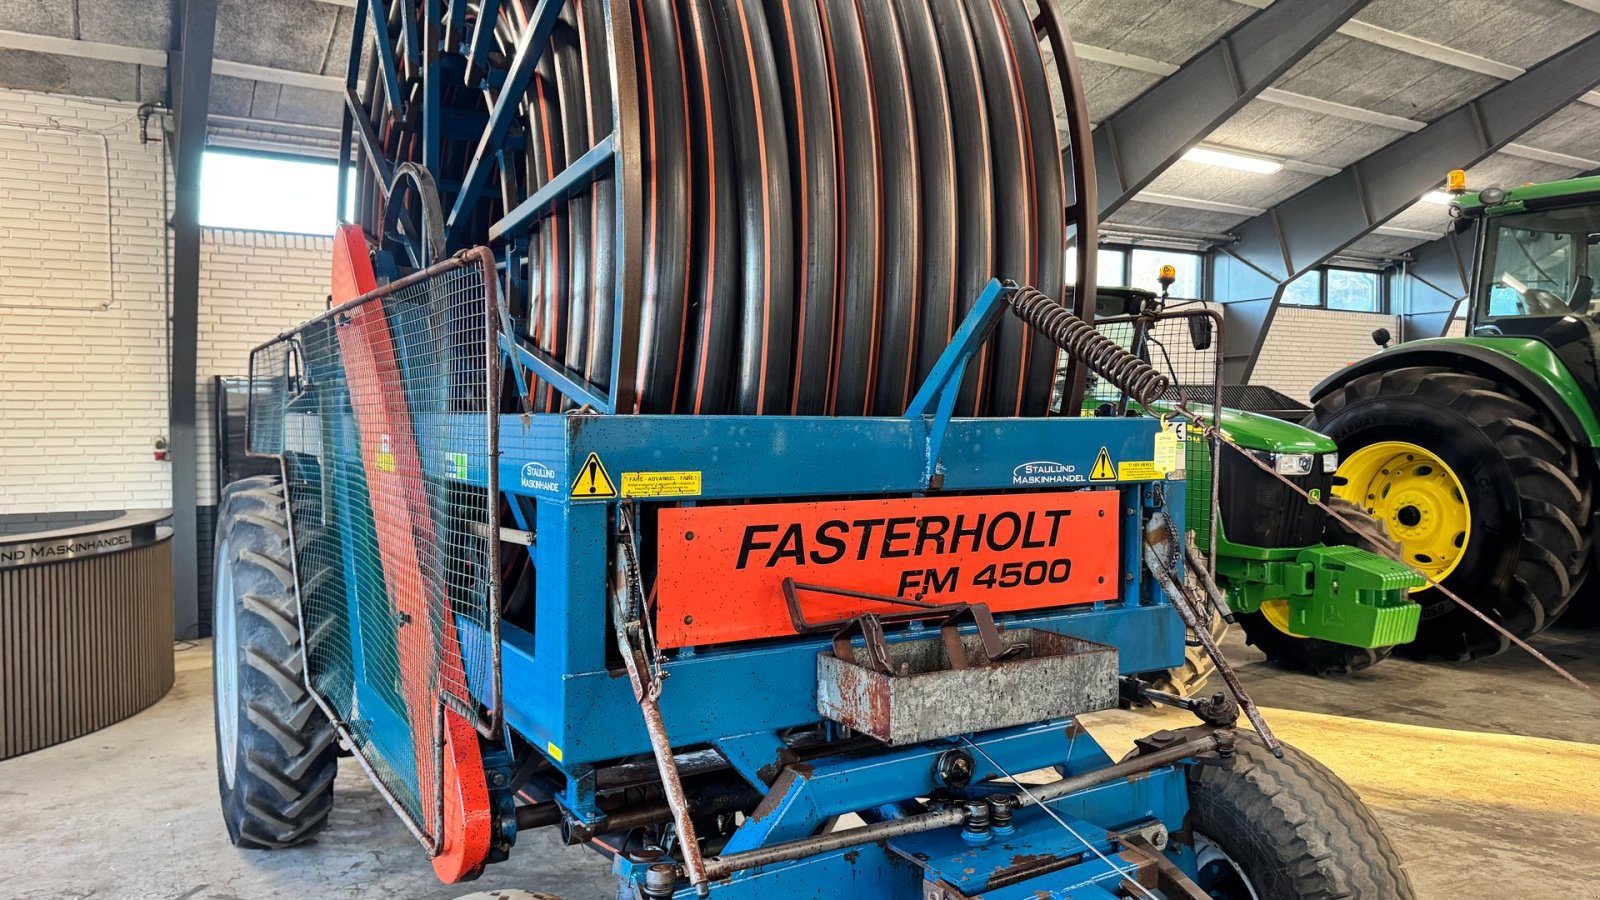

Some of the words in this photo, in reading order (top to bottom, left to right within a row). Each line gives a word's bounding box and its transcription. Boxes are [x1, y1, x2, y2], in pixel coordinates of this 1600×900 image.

[526, 466, 555, 479] STAULUND
[1025, 464, 1075, 474] STAULUND
[1013, 474, 1086, 484] MASKINHANDEL
[30, 535, 130, 559] MASKINHANDEL
[735, 509, 1072, 570] FASTERHOLT
[897, 566, 960, 598] FM
[972, 558, 1072, 588] 4500
